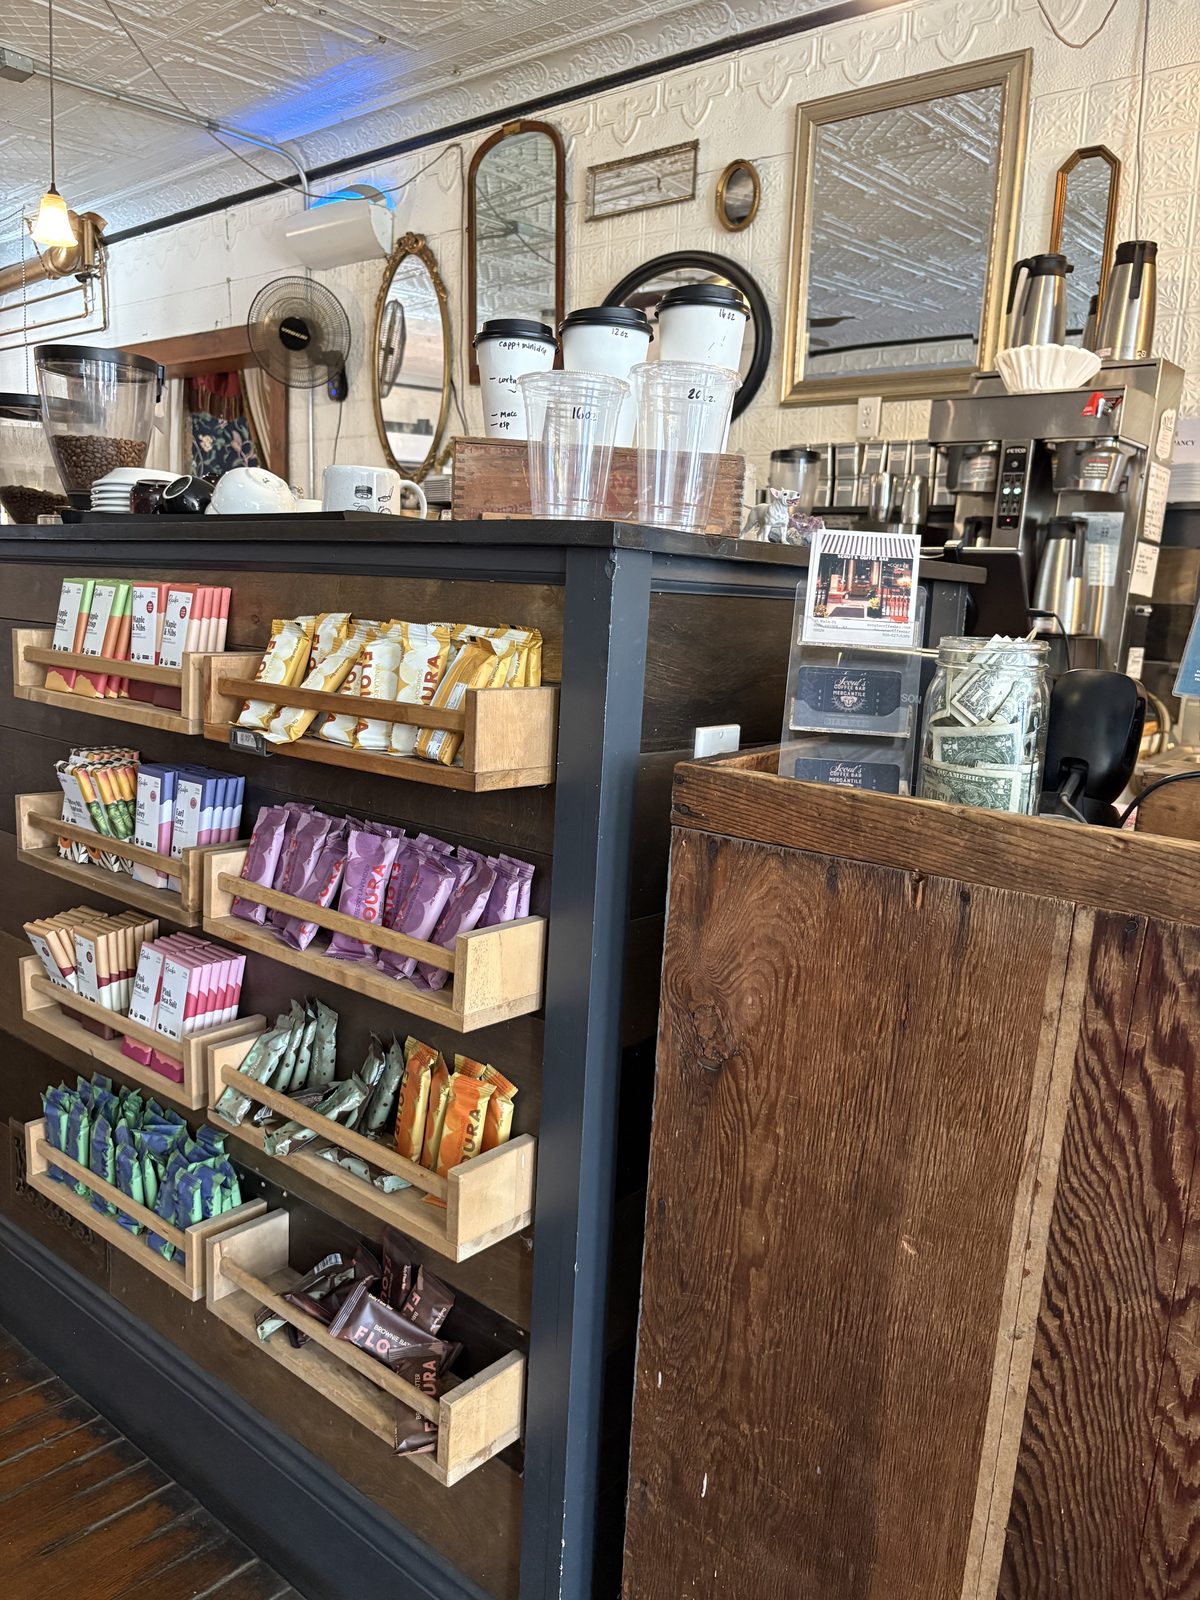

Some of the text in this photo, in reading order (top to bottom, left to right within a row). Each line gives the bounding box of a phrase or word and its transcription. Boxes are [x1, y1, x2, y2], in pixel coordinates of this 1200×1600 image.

[255, 640, 277, 681] FLO
[361, 651, 373, 698] FLO
[420, 655, 441, 706] URA
[832, 690, 867, 698] MERCANTILE
[854, 684, 867, 692] BAR
[828, 777, 863, 785] MERCANTILE
[829, 770, 863, 779] COFFEE BAR
[947, 771, 987, 783] AMERICA
[175, 816, 184, 826] Grey
[176, 808, 185, 818] Earl
[362, 863, 387, 923] OURA
[353, 1324, 392, 1354] FLO
[373, 1323, 400, 1344] BROWNIE
[422, 1359, 437, 1397] URA
